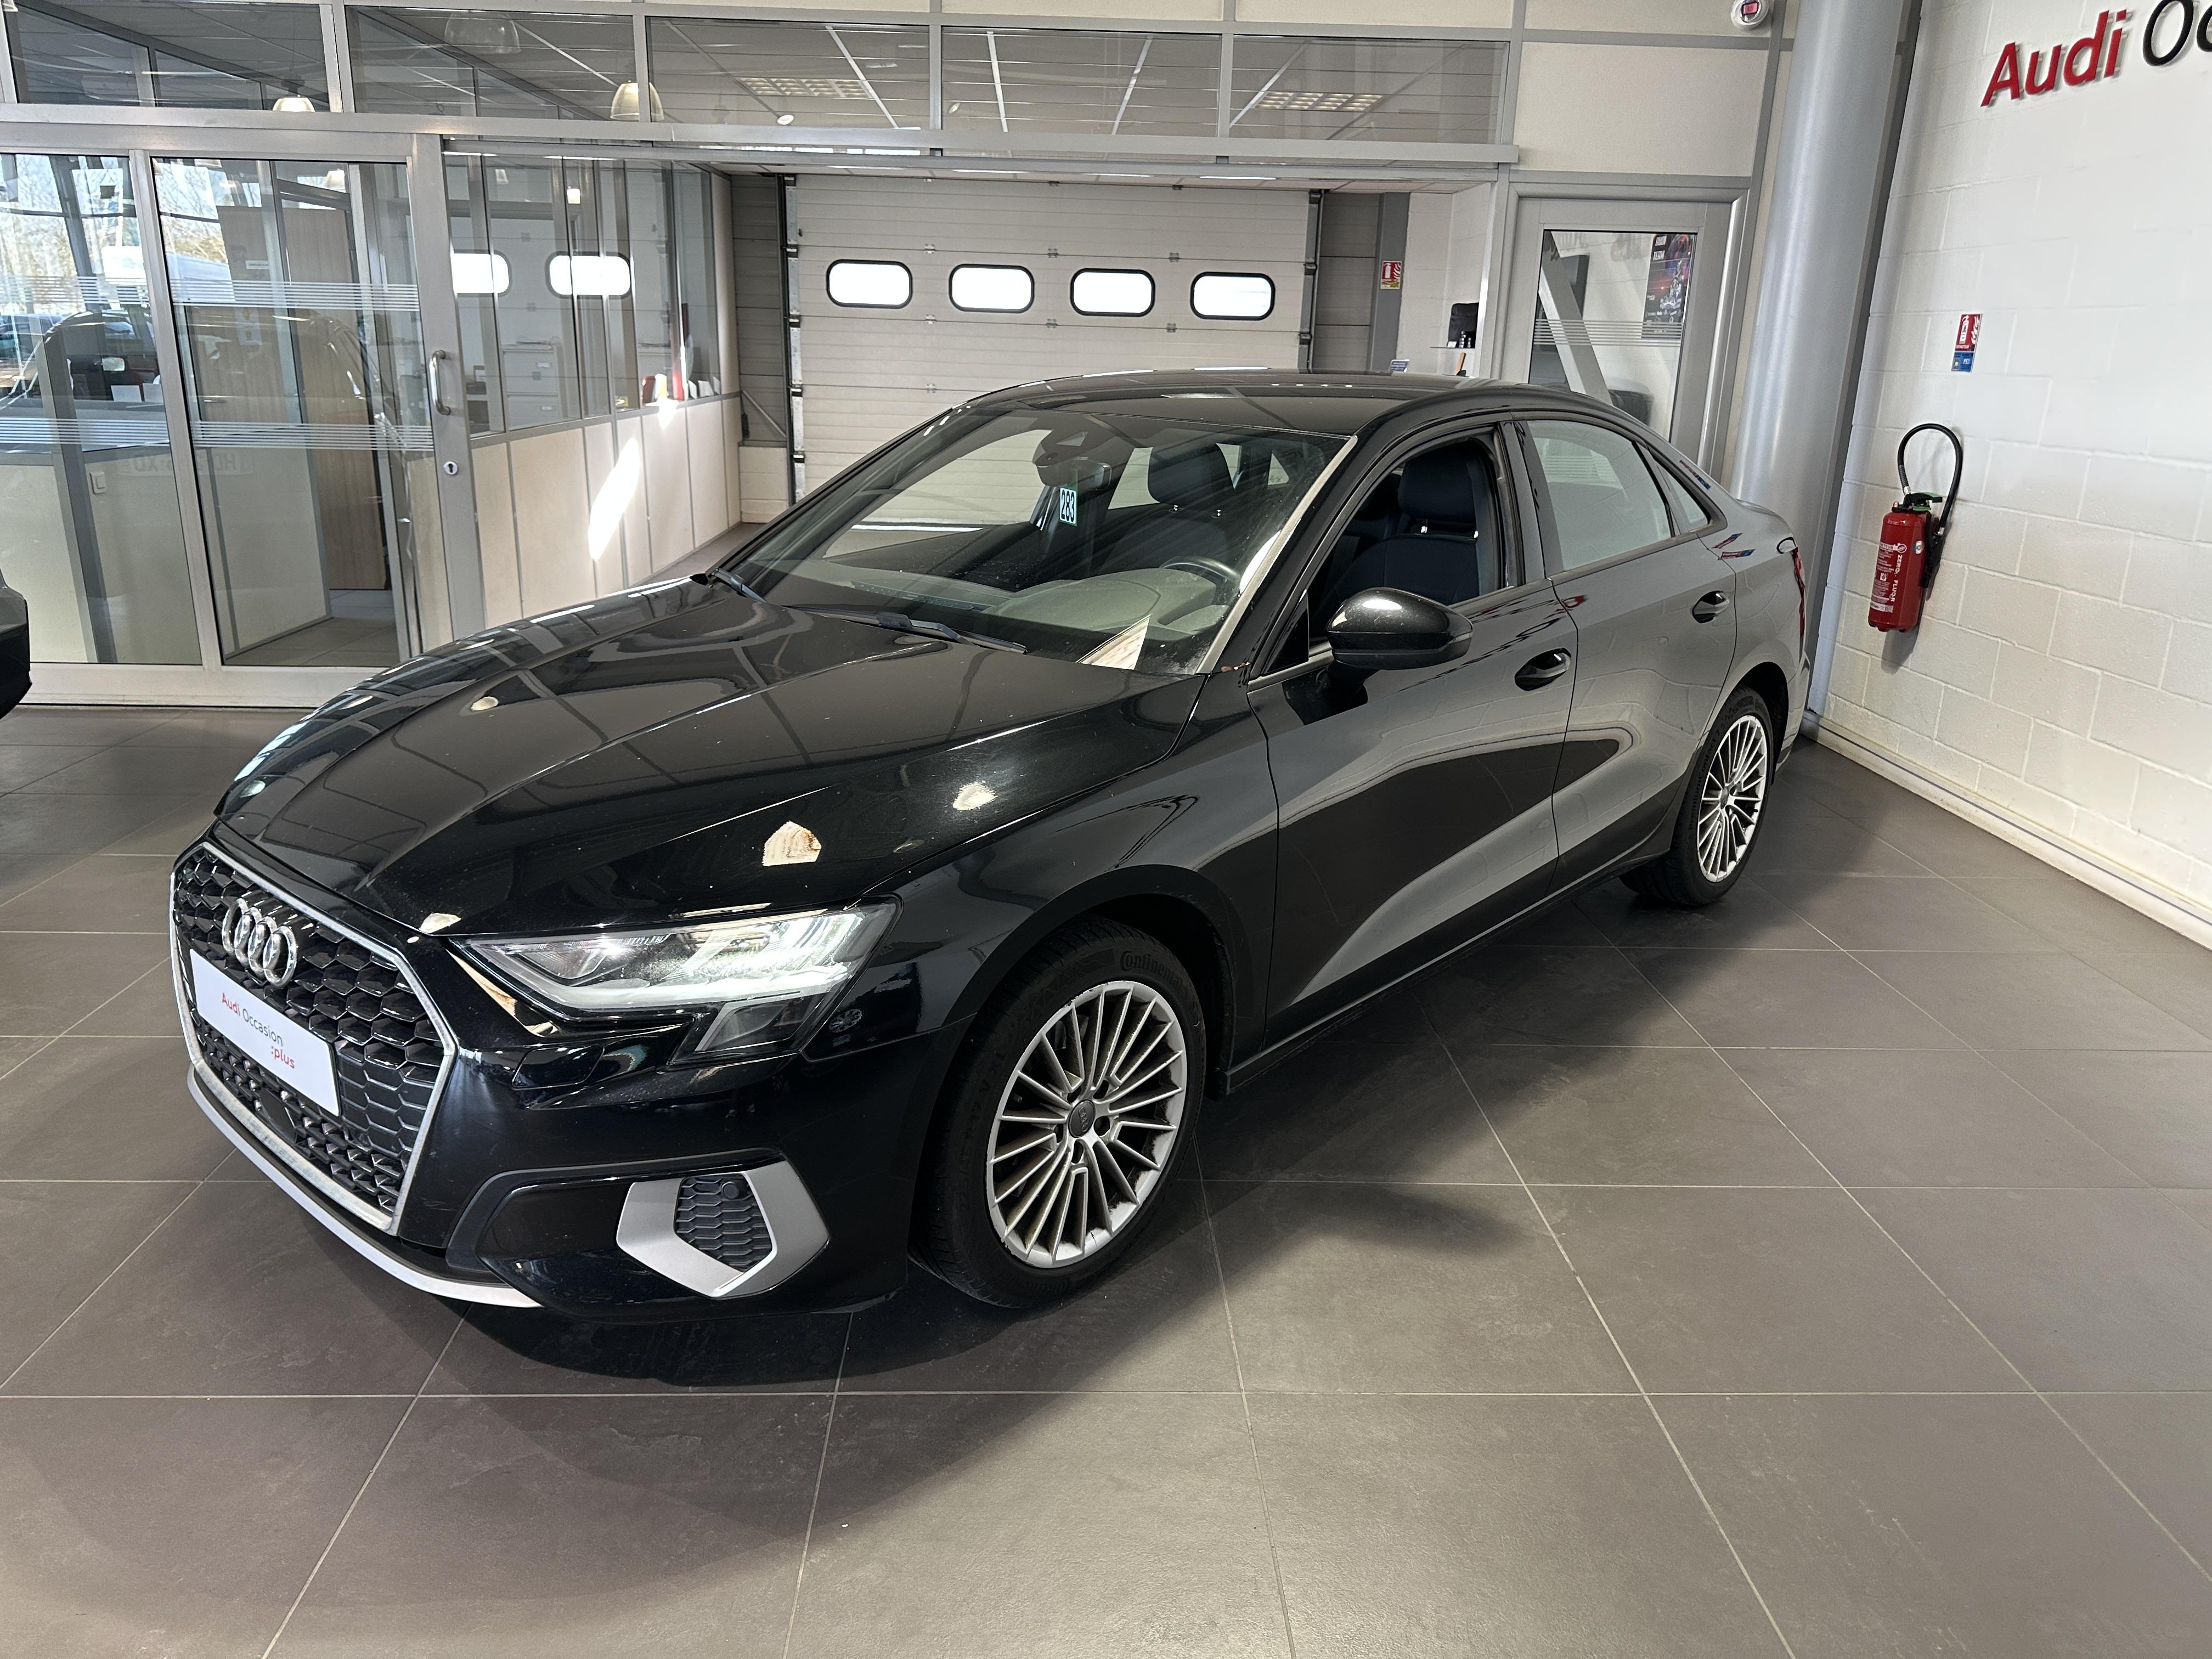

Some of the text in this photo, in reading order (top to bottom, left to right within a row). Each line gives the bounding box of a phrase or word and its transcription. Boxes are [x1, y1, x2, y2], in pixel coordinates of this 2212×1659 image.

[1980, 9, 2128, 107] Audi
[1061, 489, 1075, 522] 283
[1889, 579, 1898, 602] FLUOR
[1120, 950, 1183, 990] Continental
[221, 992, 283, 1046] Audi Occasion
